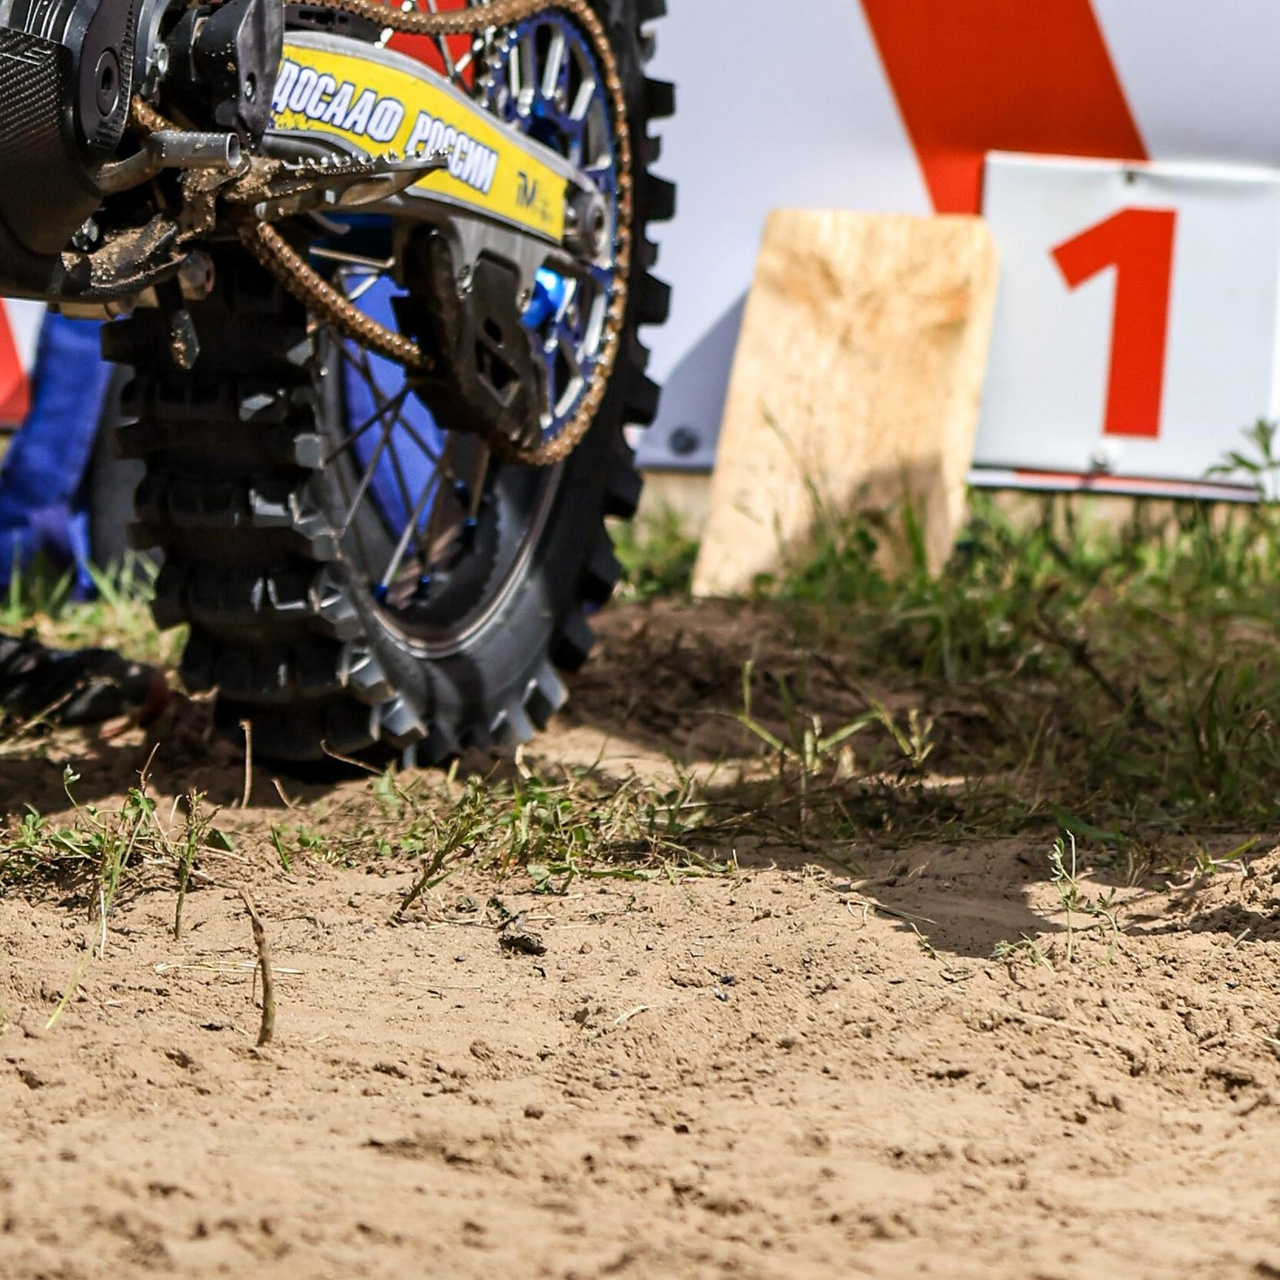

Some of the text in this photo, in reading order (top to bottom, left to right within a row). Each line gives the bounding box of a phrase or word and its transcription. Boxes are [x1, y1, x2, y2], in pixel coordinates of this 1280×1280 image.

[271, 57, 499, 196] ДОСААФ РОССИИ
[1049, 206, 1178, 440] 1
